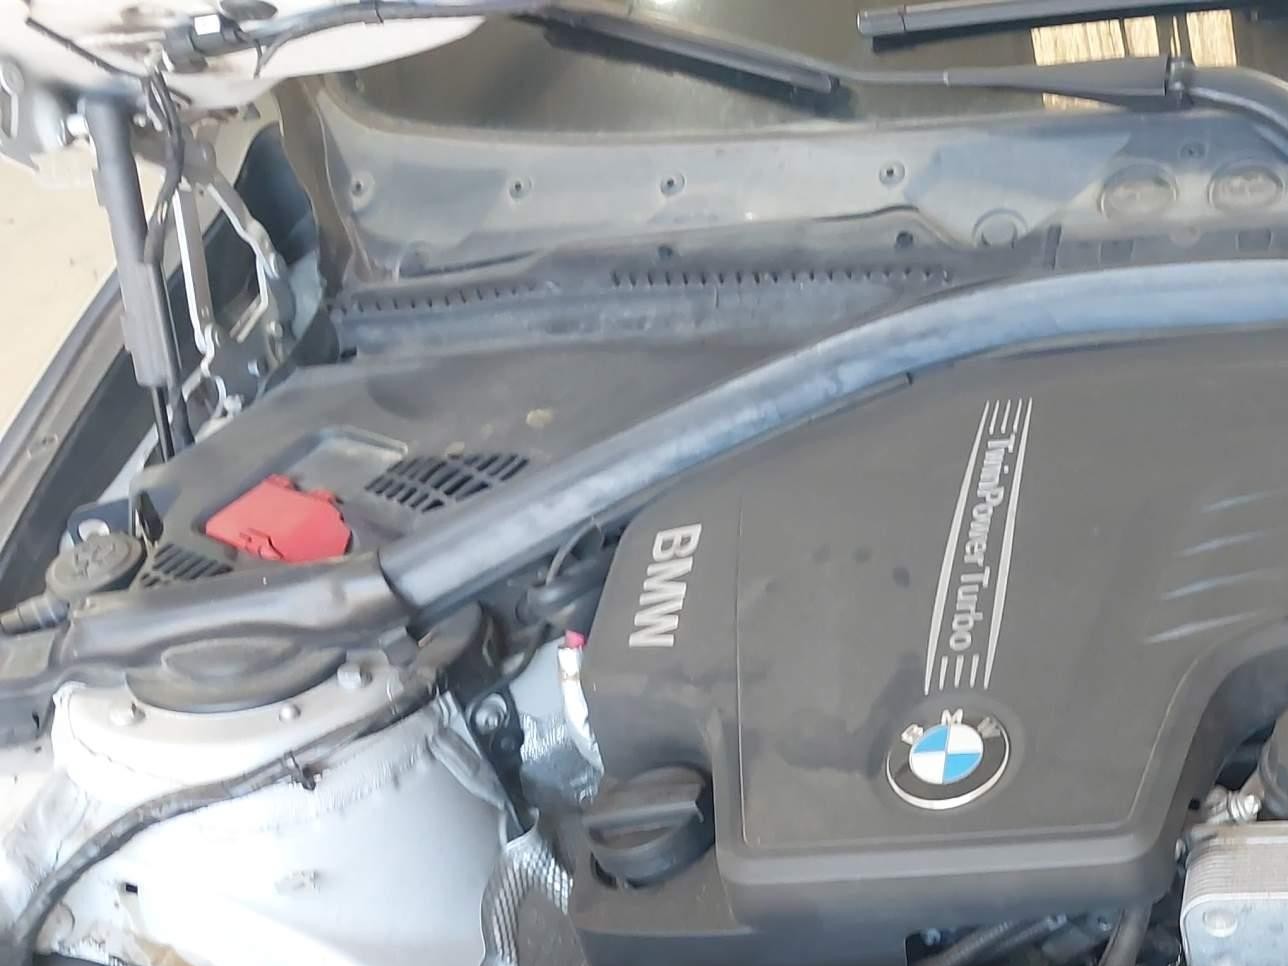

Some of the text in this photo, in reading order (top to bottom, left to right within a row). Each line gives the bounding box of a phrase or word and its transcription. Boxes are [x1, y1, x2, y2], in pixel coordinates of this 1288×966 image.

[628, 523, 702, 648] BMW
[949, 432, 1016, 651] TwinPower Turbo
